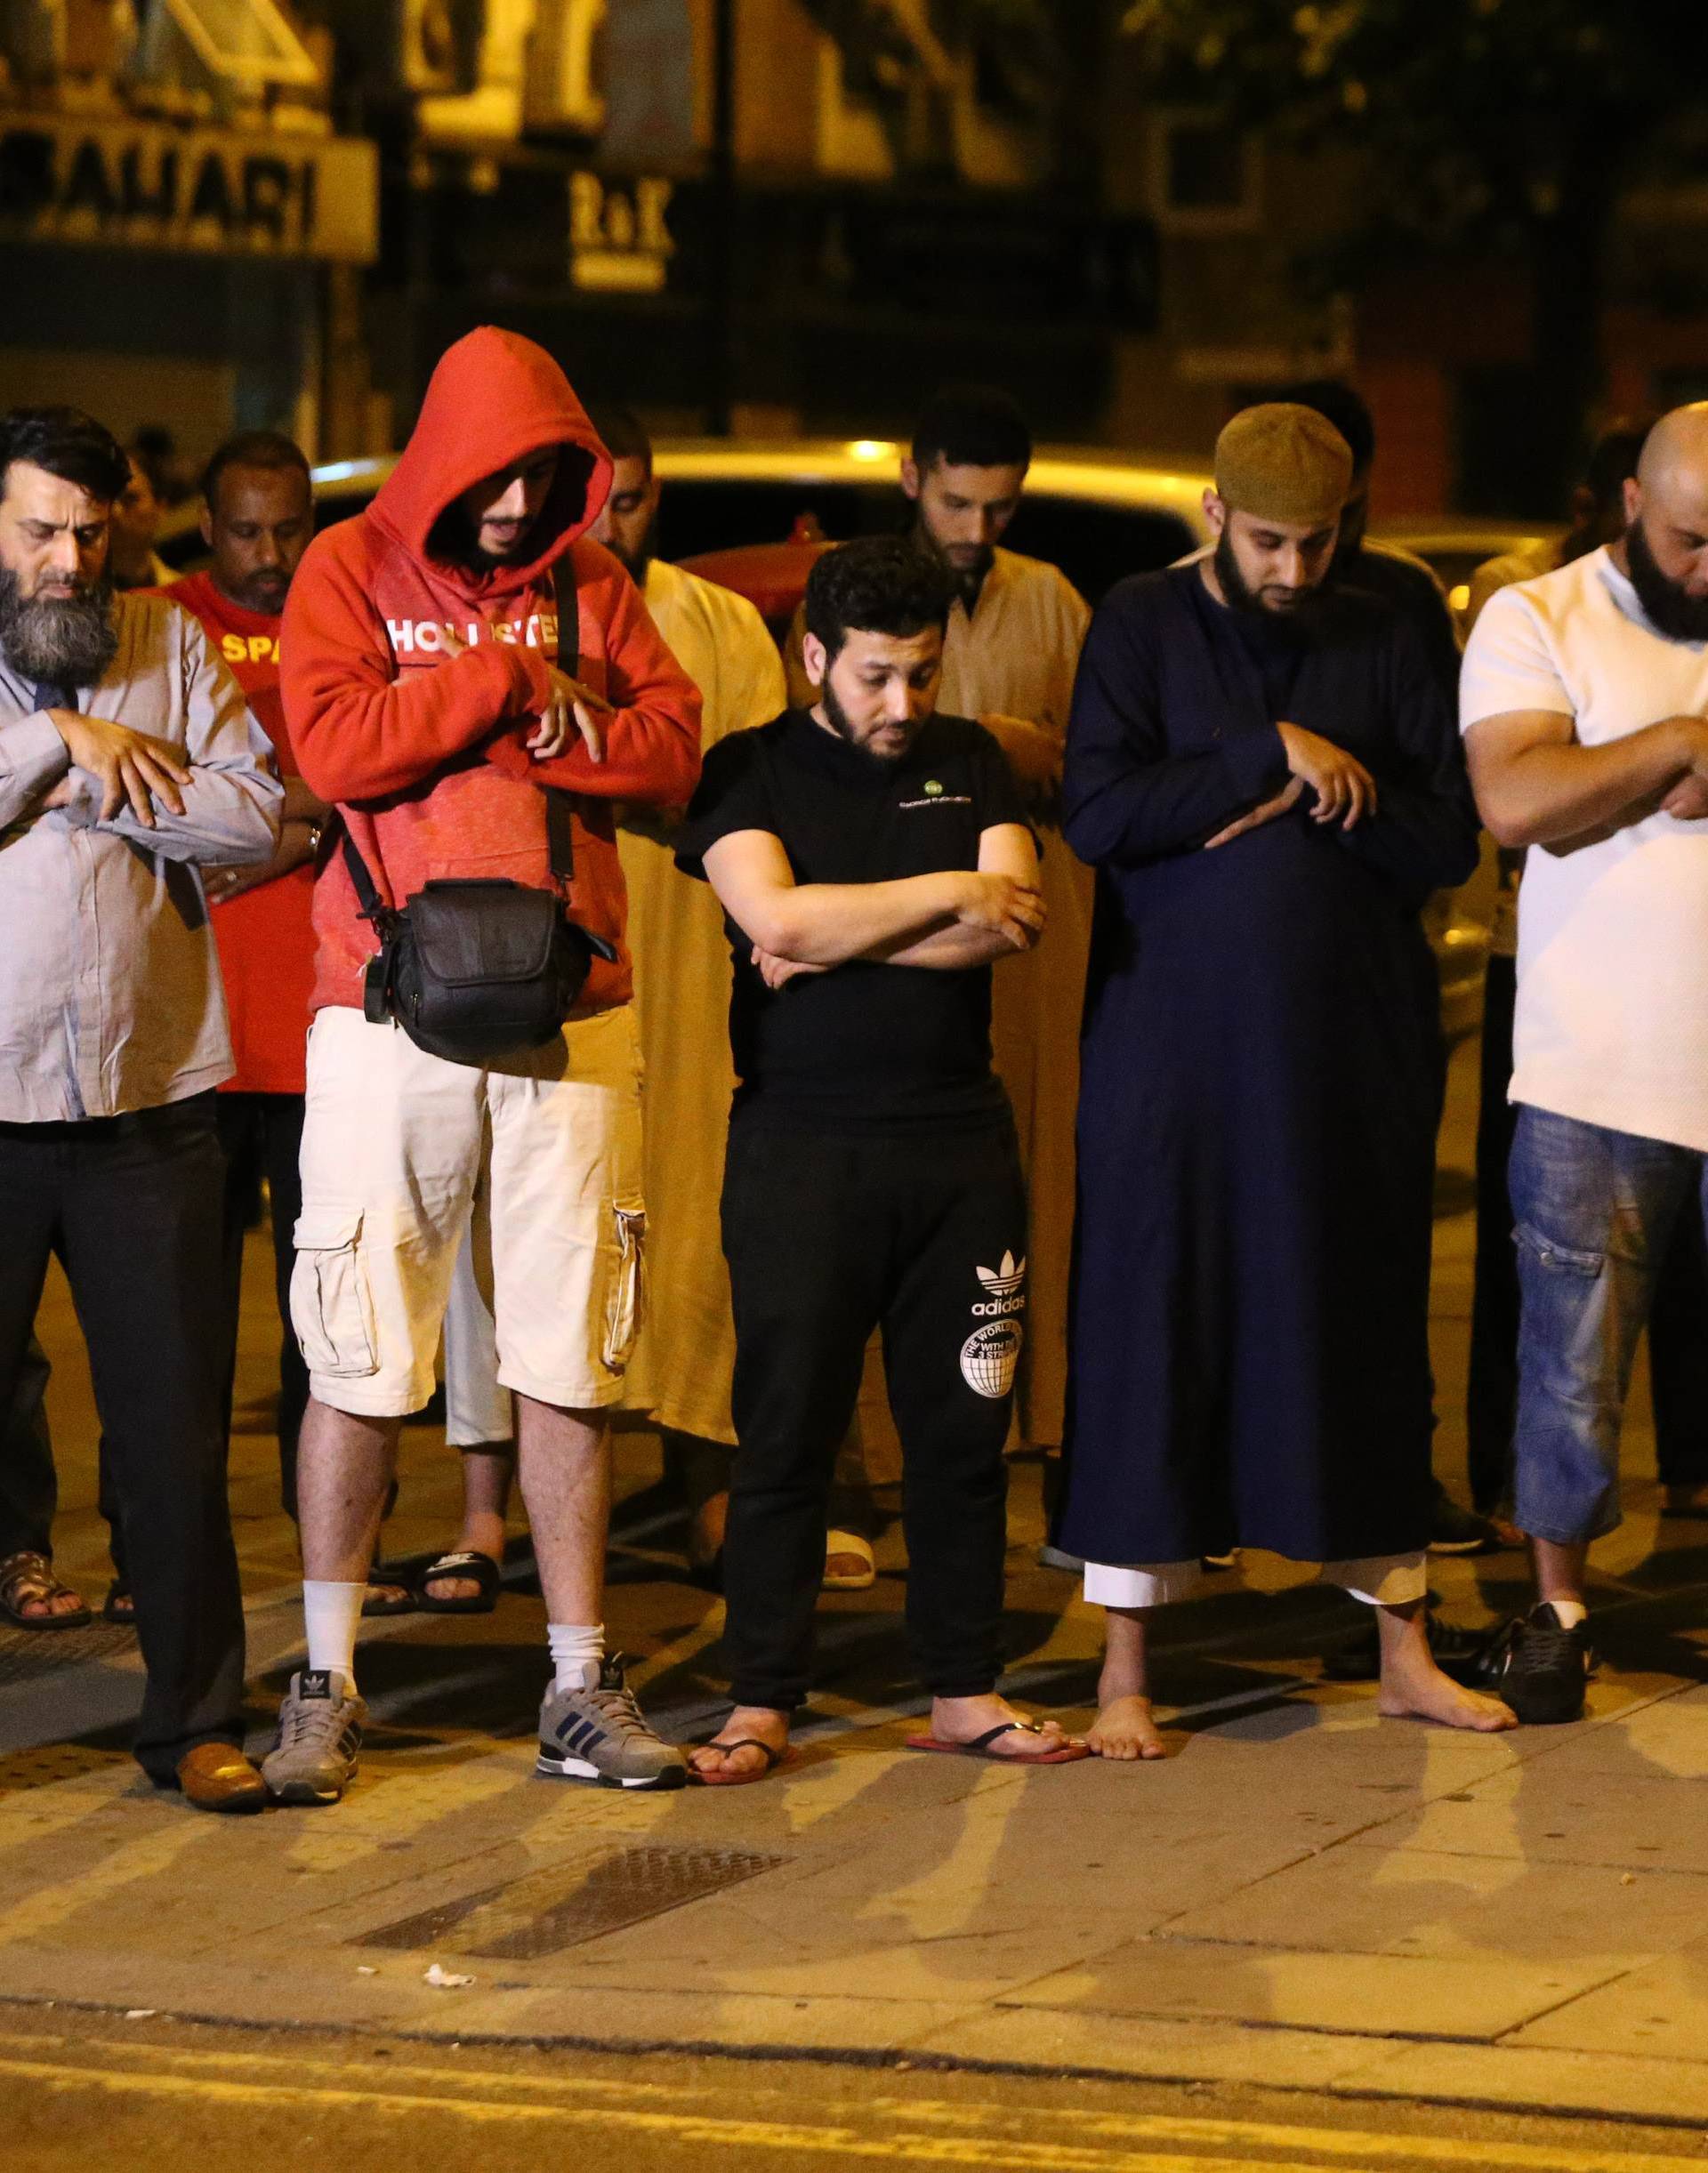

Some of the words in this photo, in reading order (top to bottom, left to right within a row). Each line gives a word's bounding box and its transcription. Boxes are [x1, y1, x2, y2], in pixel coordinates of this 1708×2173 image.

[971, 1295, 1025, 1316] adidas
[965, 1339, 980, 1357] THE
[980, 1342, 1004, 1351] WITH
[978, 1351, 984, 1359] 3
